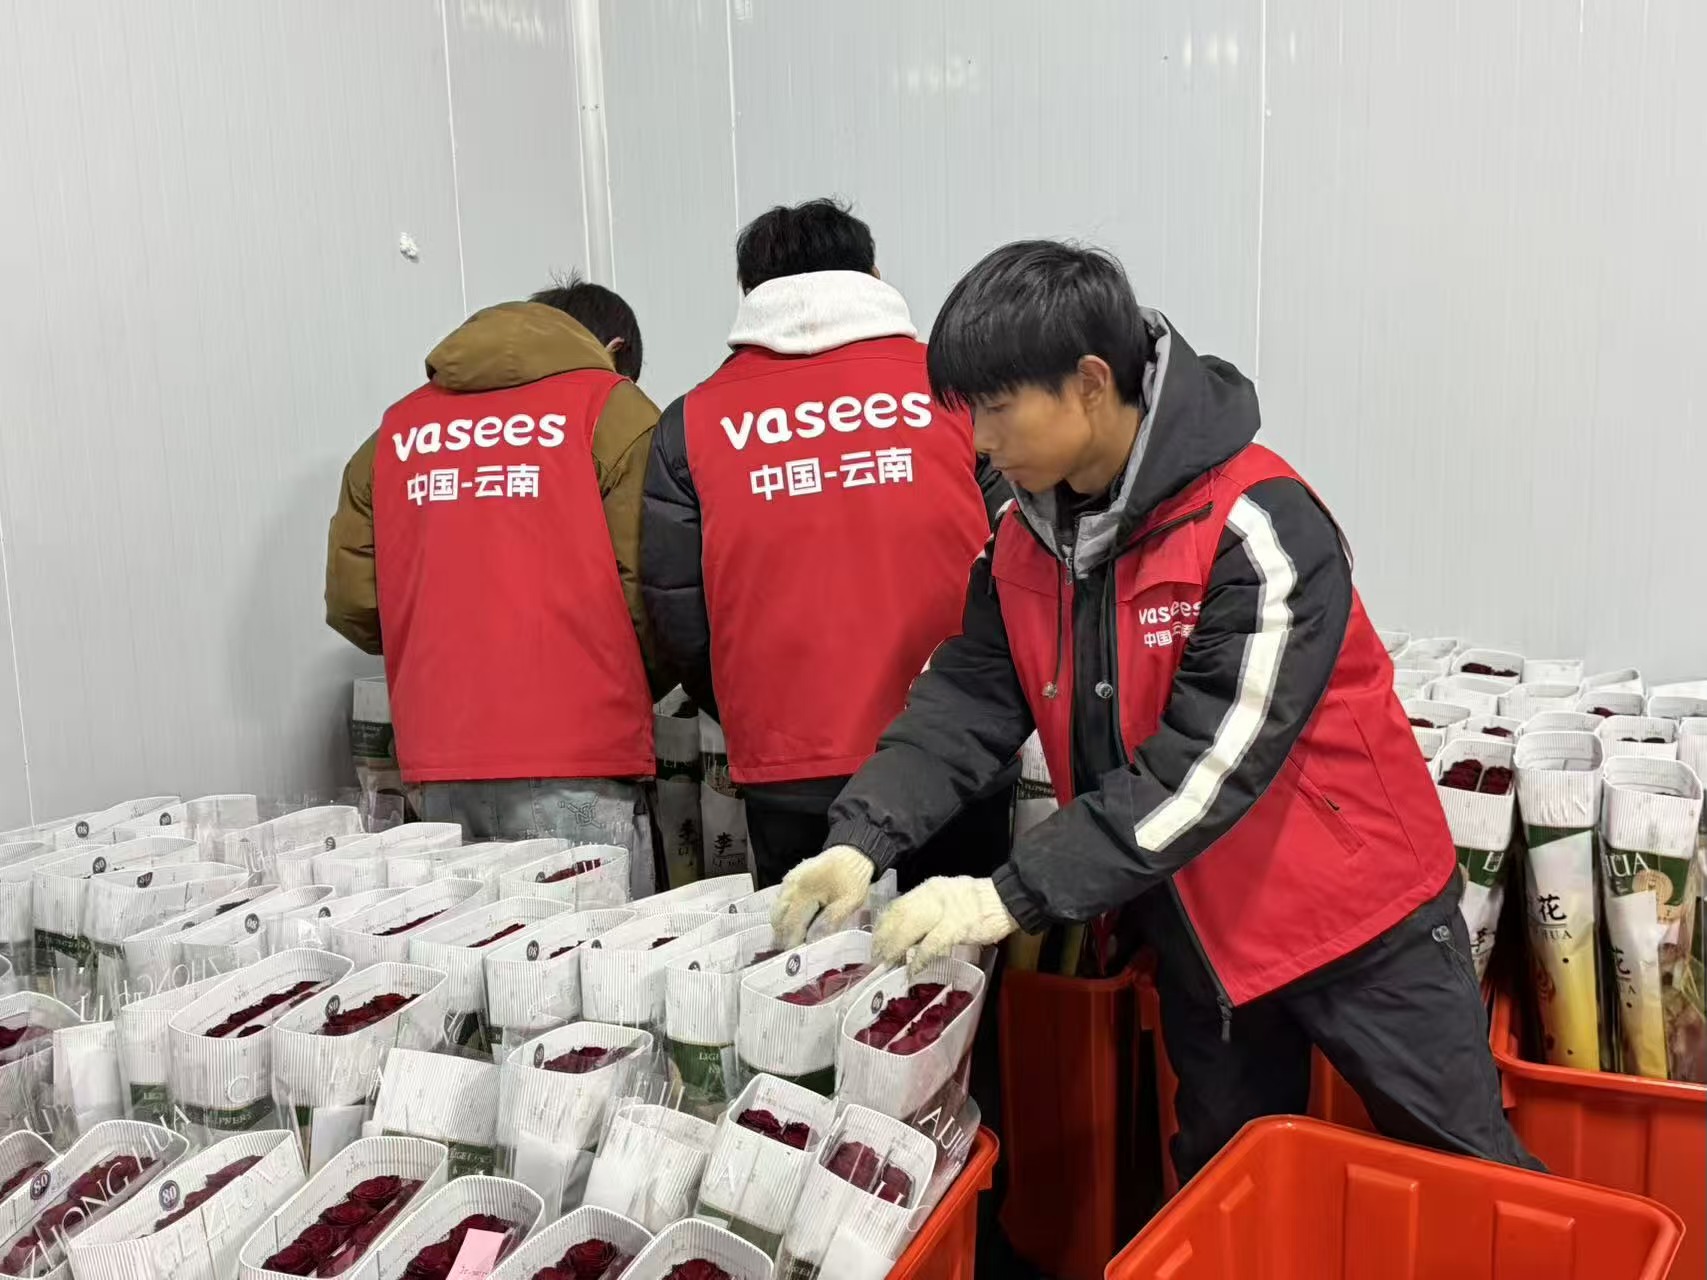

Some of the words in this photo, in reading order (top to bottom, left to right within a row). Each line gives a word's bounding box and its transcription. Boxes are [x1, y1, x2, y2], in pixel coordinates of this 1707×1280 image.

[392, 412, 567, 462] vasees
[720, 391, 933, 451] vasees
[406, 463, 541, 506] 中国-云南
[749, 447, 914, 501] 中国-云南
[1537, 894, 1568, 922] 花
